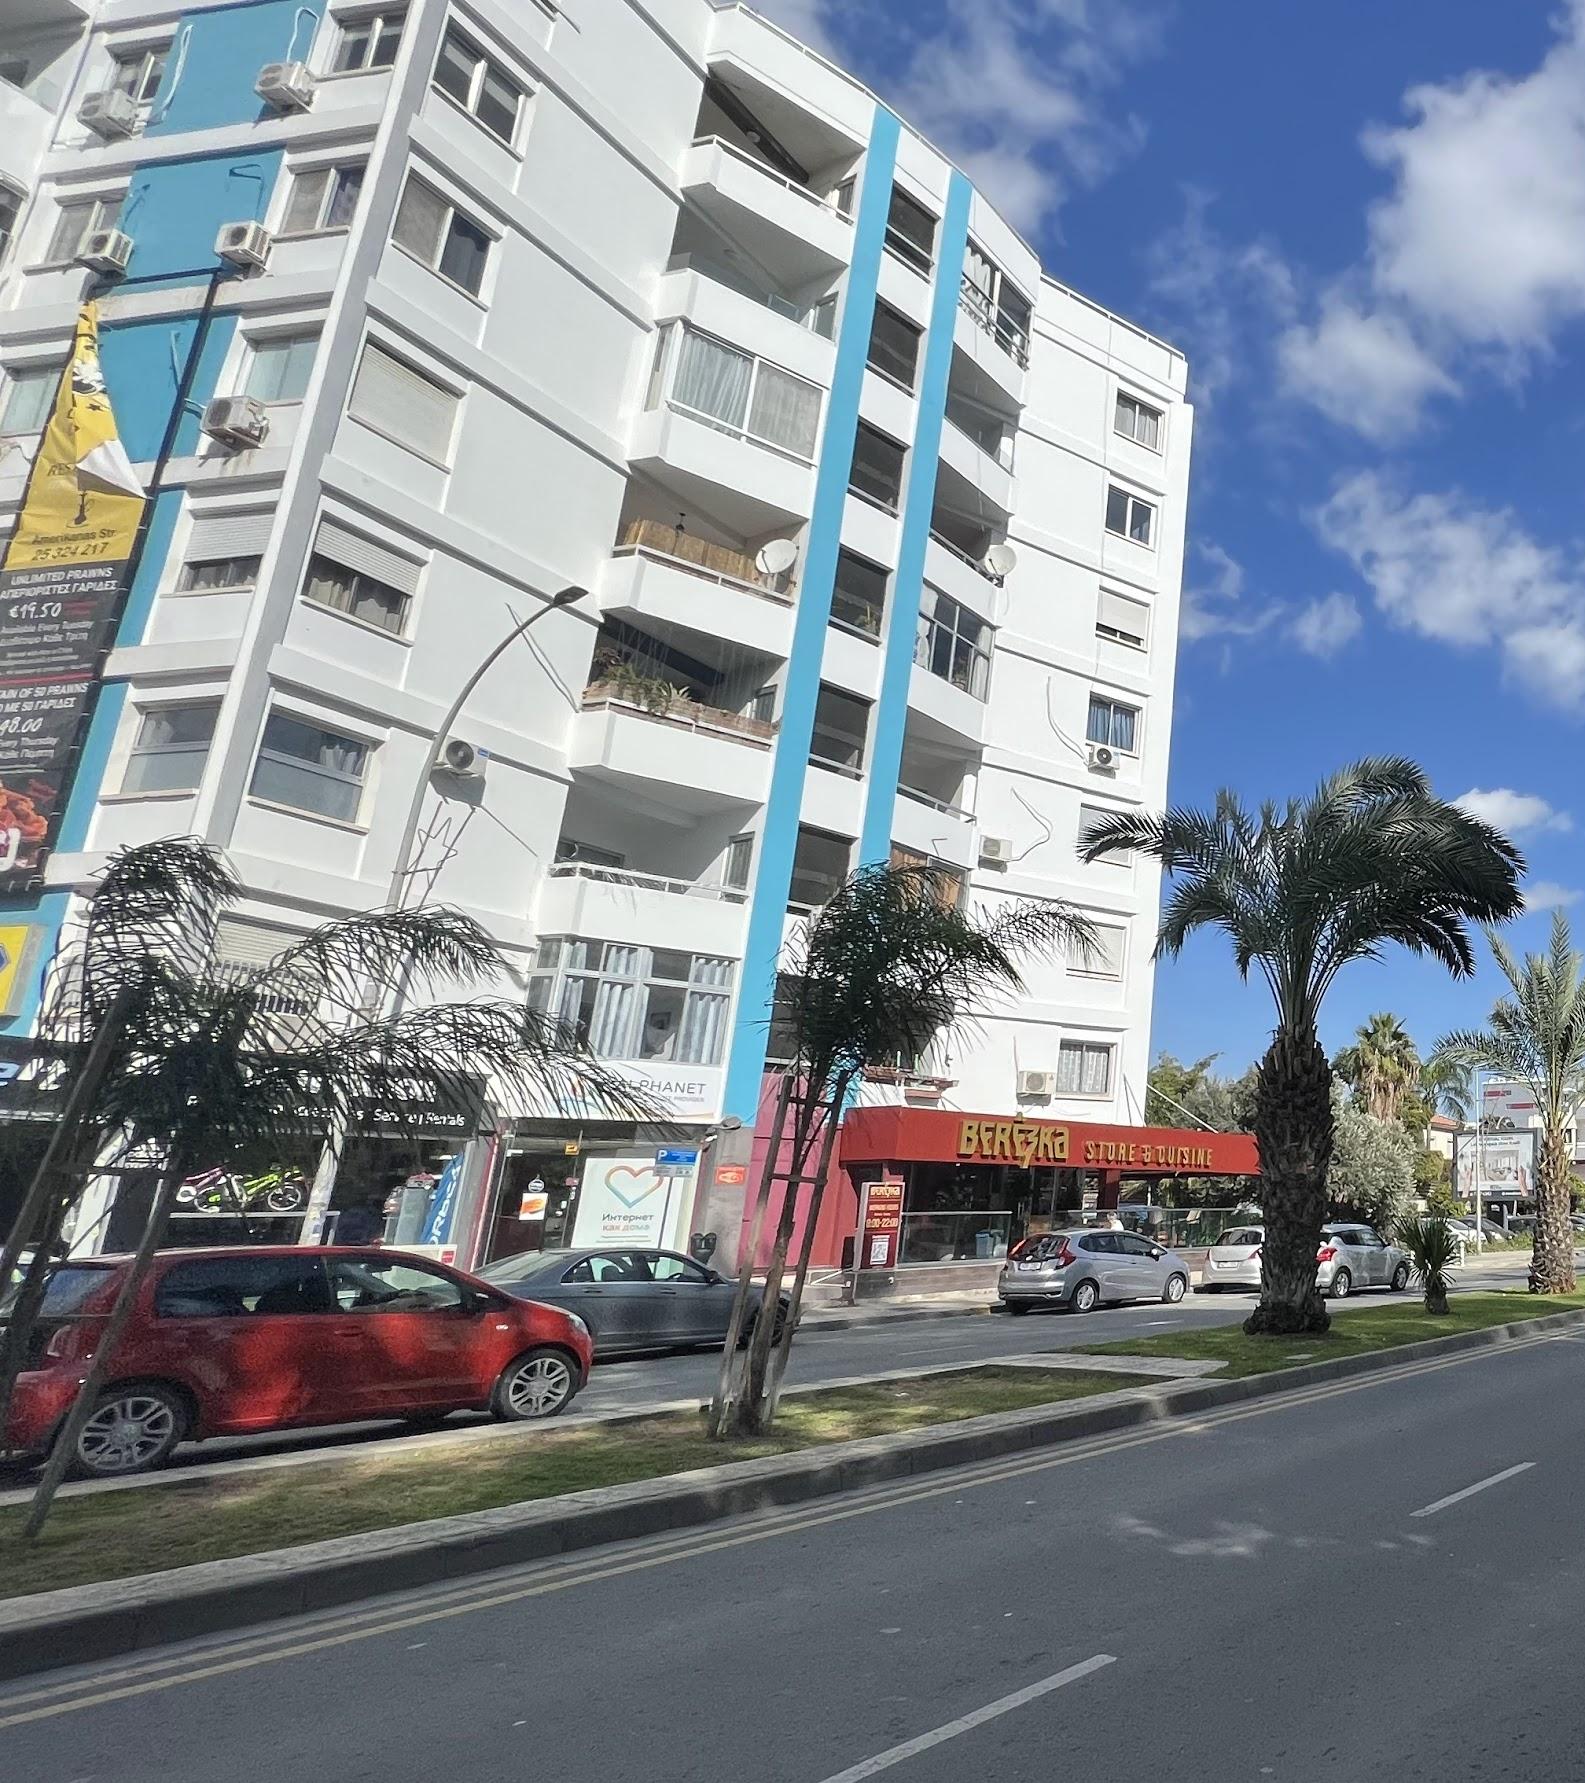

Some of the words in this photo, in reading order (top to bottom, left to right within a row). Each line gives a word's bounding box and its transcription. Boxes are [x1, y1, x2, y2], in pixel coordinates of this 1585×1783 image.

[11, 571, 65, 586] UNLIMITED
[66, 567, 114, 580] PRAWNS
[71, 580, 118, 593] ΓΑΡΙΔΕΣ
[9, 602, 62, 619] €19.50
[47, 682, 89, 695] PRAWNS
[1084, 1140, 1136, 1164] STORE
[602, 1213, 654, 1224] Интернет
